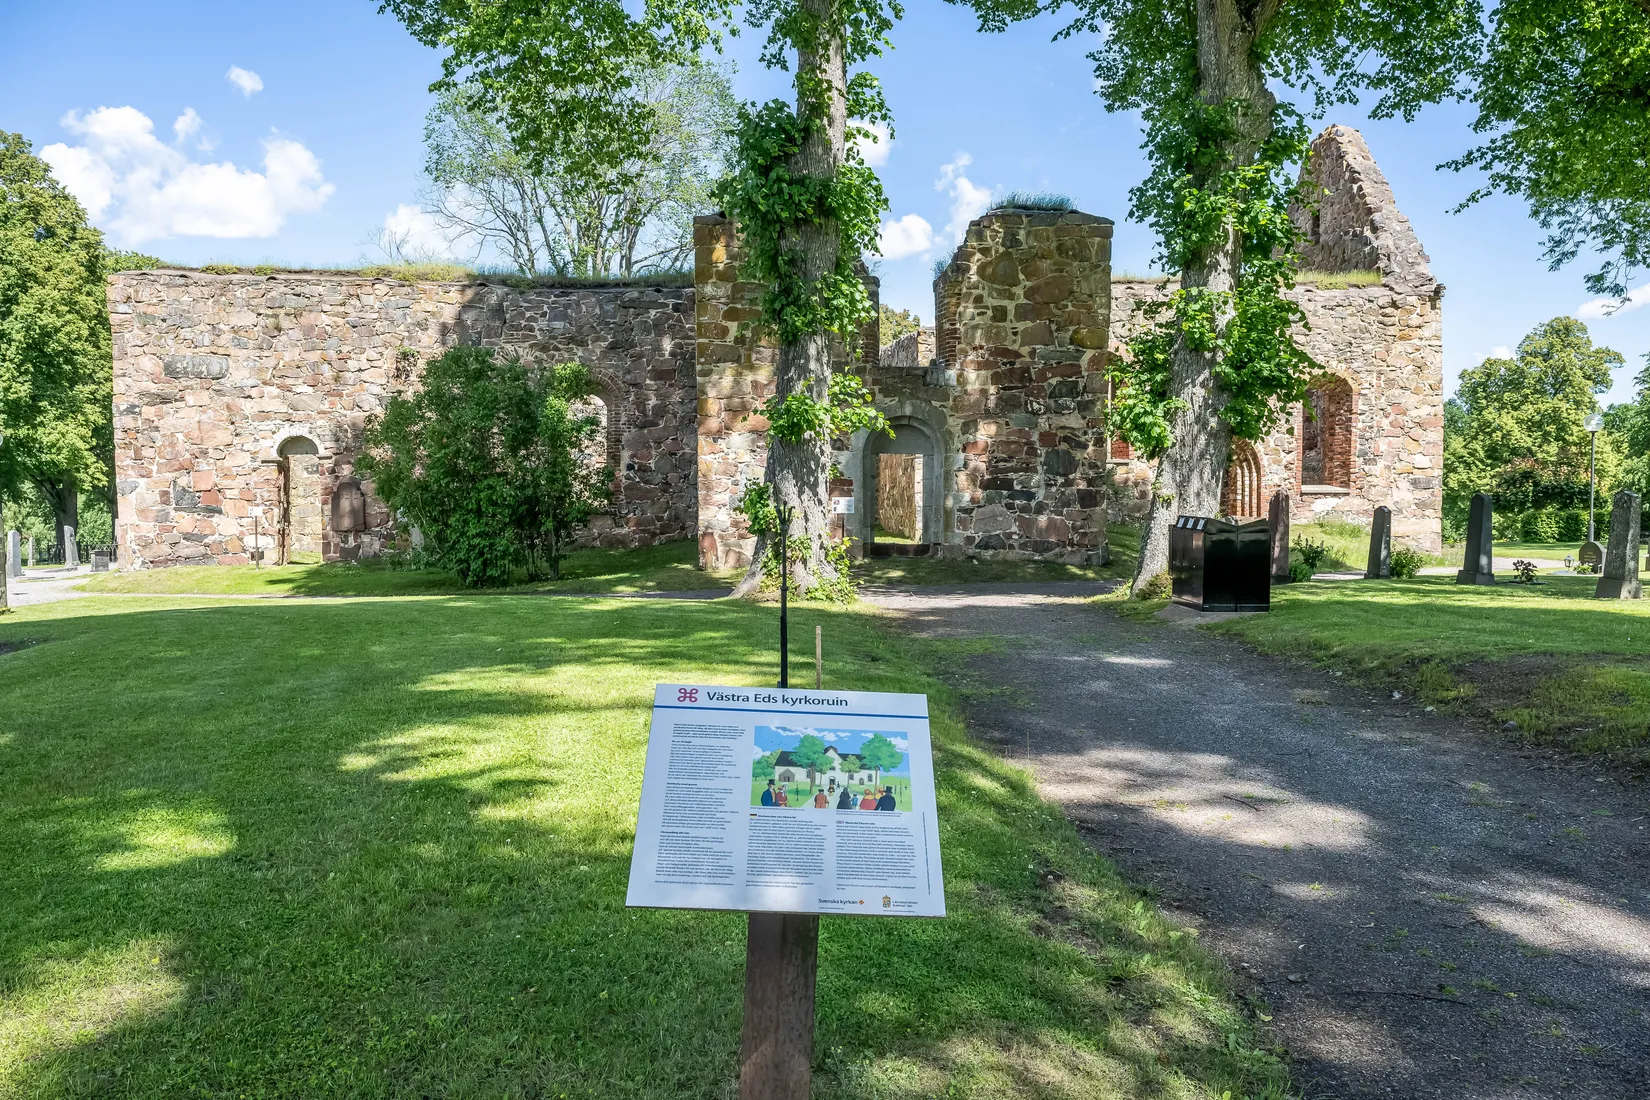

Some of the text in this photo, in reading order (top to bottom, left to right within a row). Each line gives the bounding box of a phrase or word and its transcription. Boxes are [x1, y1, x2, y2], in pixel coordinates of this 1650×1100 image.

[707, 691, 848, 707] Västra Eds kyrkoruin
